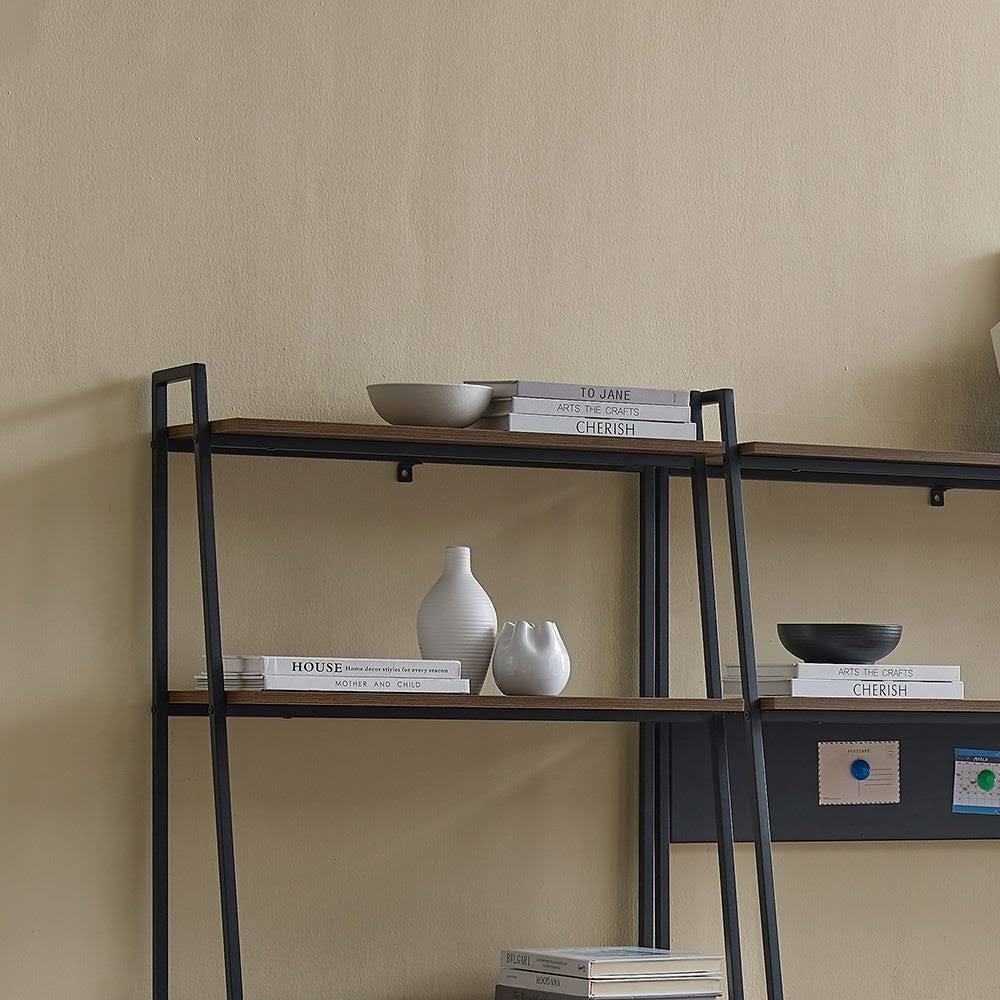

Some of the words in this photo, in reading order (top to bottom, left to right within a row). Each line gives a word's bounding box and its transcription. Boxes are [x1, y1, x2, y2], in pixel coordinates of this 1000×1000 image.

[581, 388, 595, 398] TO
[600, 389, 631, 400] JANE
[557, 404, 580, 412] ARTS
[584, 405, 601, 414] THE
[605, 406, 640, 416] CRAFTS
[576, 421, 635, 435] CHERISH
[291, 662, 343, 673] HOUSE
[838, 668, 859, 676] ARTS
[864, 668, 878, 677] THE
[882, 668, 913, 678] CRAFTS
[334, 680, 368, 688] MOTHER
[853, 683, 907, 697] CHERISH
